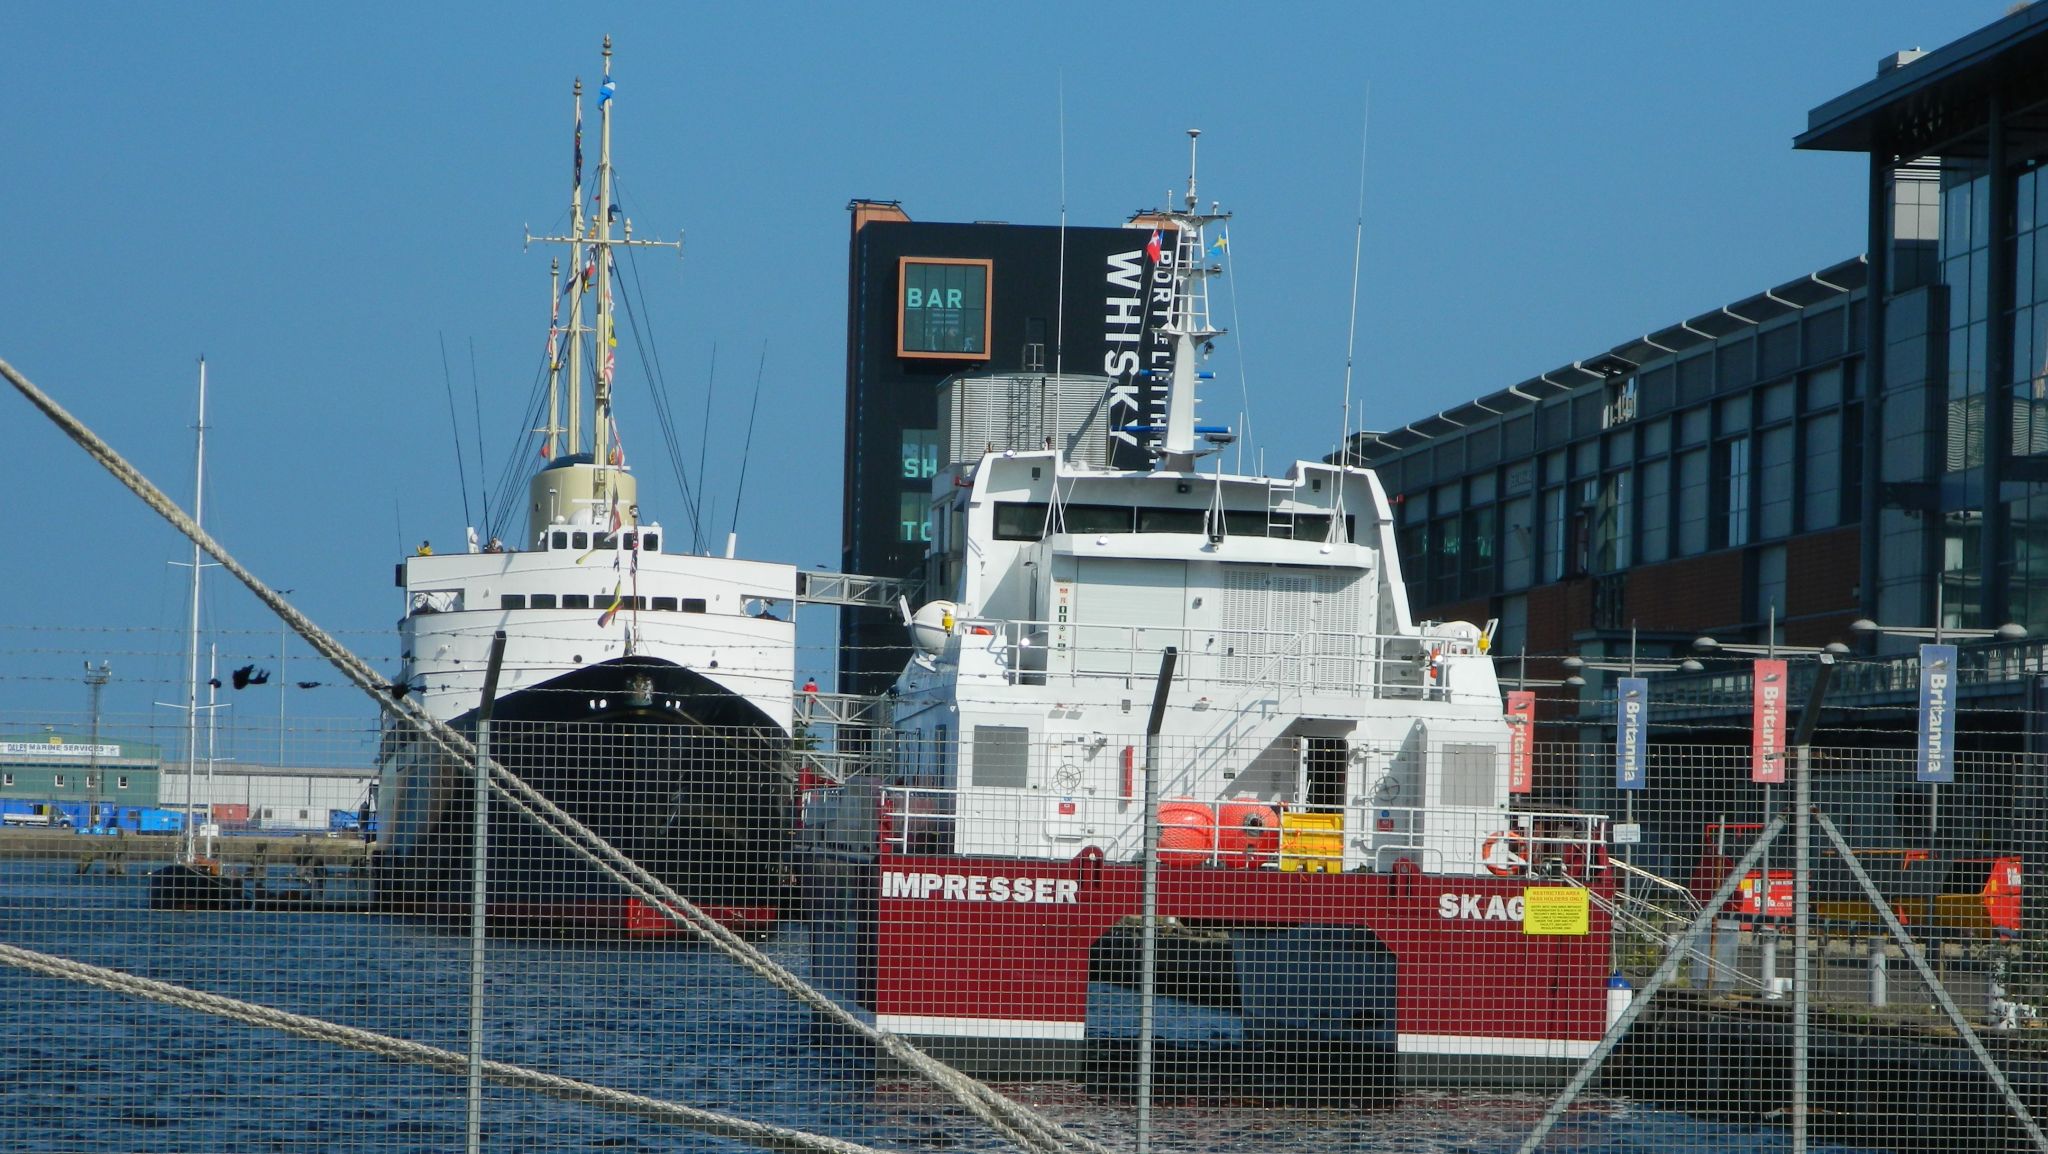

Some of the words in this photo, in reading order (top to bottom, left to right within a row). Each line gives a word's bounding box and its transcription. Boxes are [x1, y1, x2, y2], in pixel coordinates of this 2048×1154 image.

[907, 287, 962, 309] BAR
[1105, 249, 1143, 448] WHISKY
[29, 744, 61, 752] MARINE
[1624, 701, 1640, 782] Britannia
[1928, 673, 1948, 773] Britannia
[881, 871, 1079, 904] IMPRESSER
